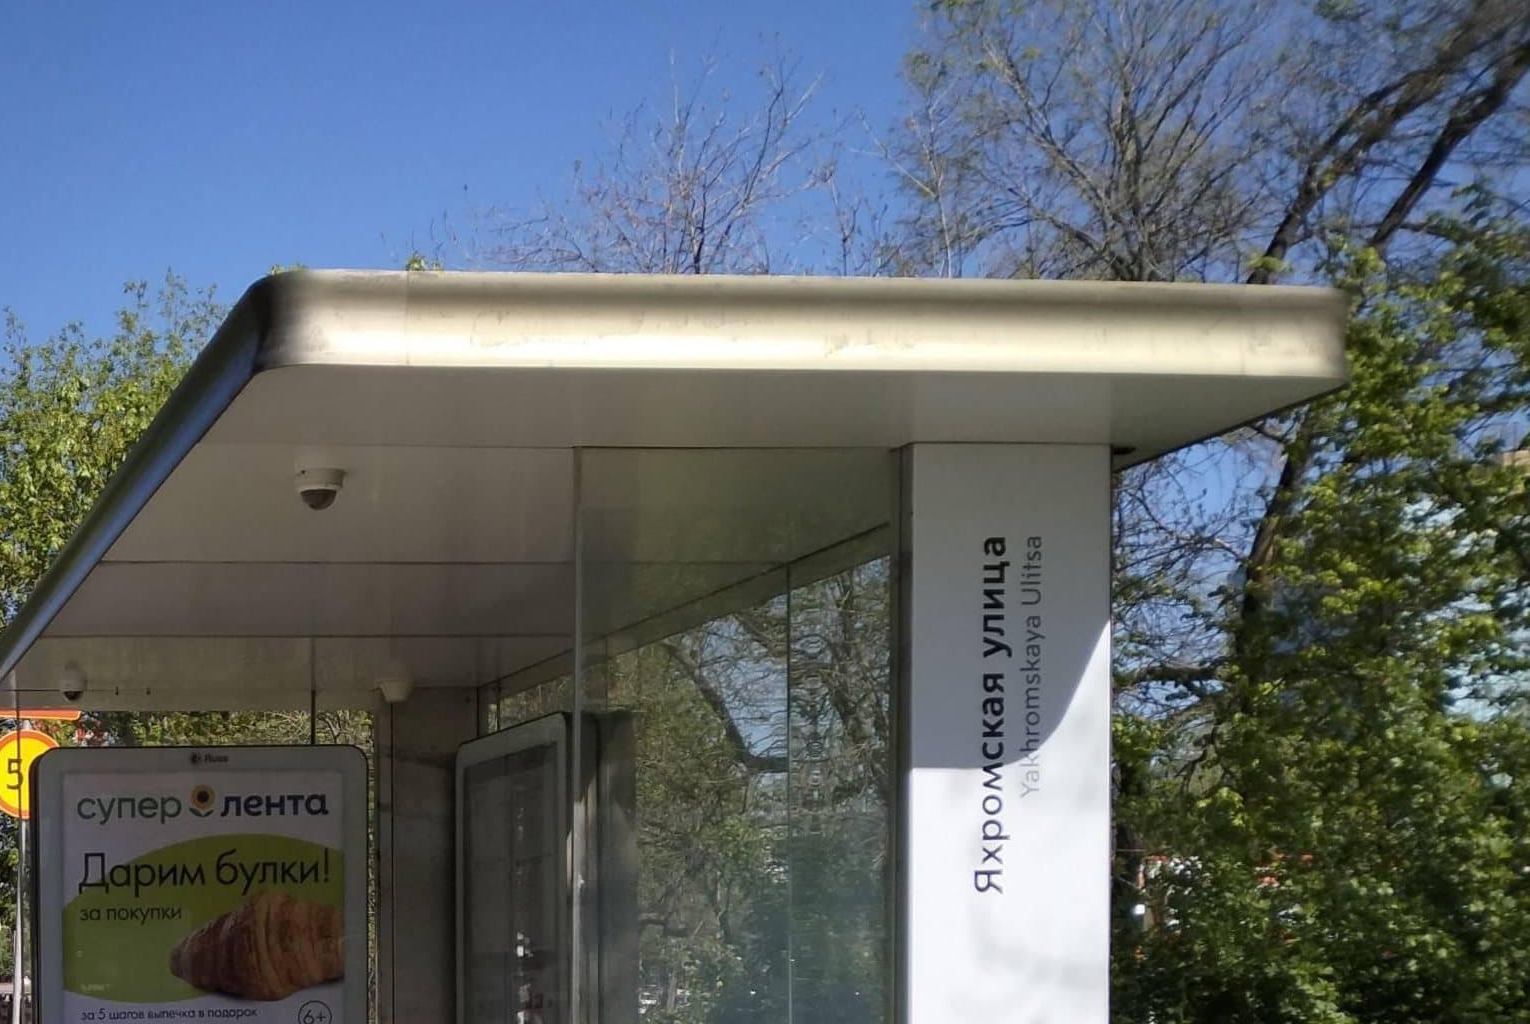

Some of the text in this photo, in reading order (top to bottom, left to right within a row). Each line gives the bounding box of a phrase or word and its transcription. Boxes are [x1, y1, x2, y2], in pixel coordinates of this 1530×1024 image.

[1020, 534, 1047, 799] Yakhromskaya Ulitsa
[974, 535, 1012, 895] Яхромская улица
[76, 792, 330, 825] супер лента
[78, 848, 331, 898] Дарим булки!
[79, 905, 183, 926] за покупки
[80, 1007, 259, 1021] за 5 шагов выпечка в подарок
